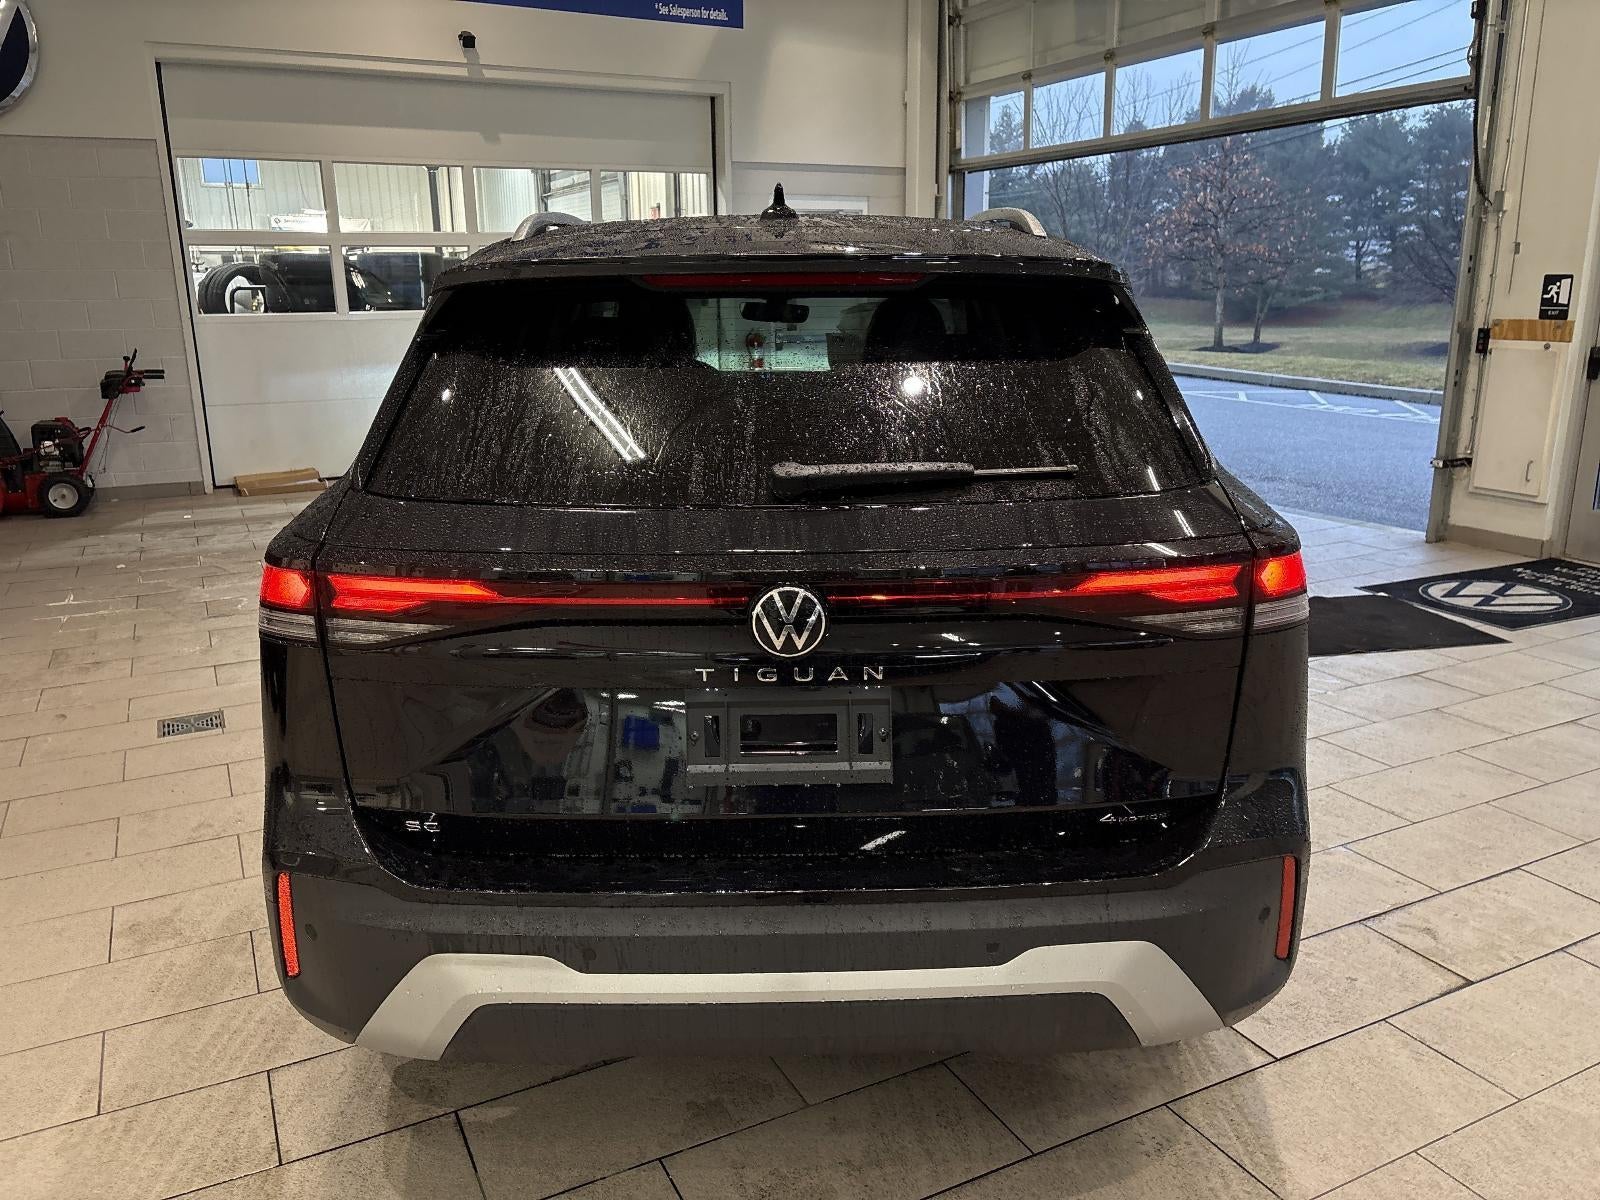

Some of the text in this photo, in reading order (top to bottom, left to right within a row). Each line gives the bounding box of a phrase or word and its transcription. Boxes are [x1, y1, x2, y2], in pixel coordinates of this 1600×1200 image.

[670, 4, 700, 19] Salesperson
[701, 7, 710, 19] for
[709, 8, 729, 20] details.
[694, 666, 884, 682] TIGUAN
